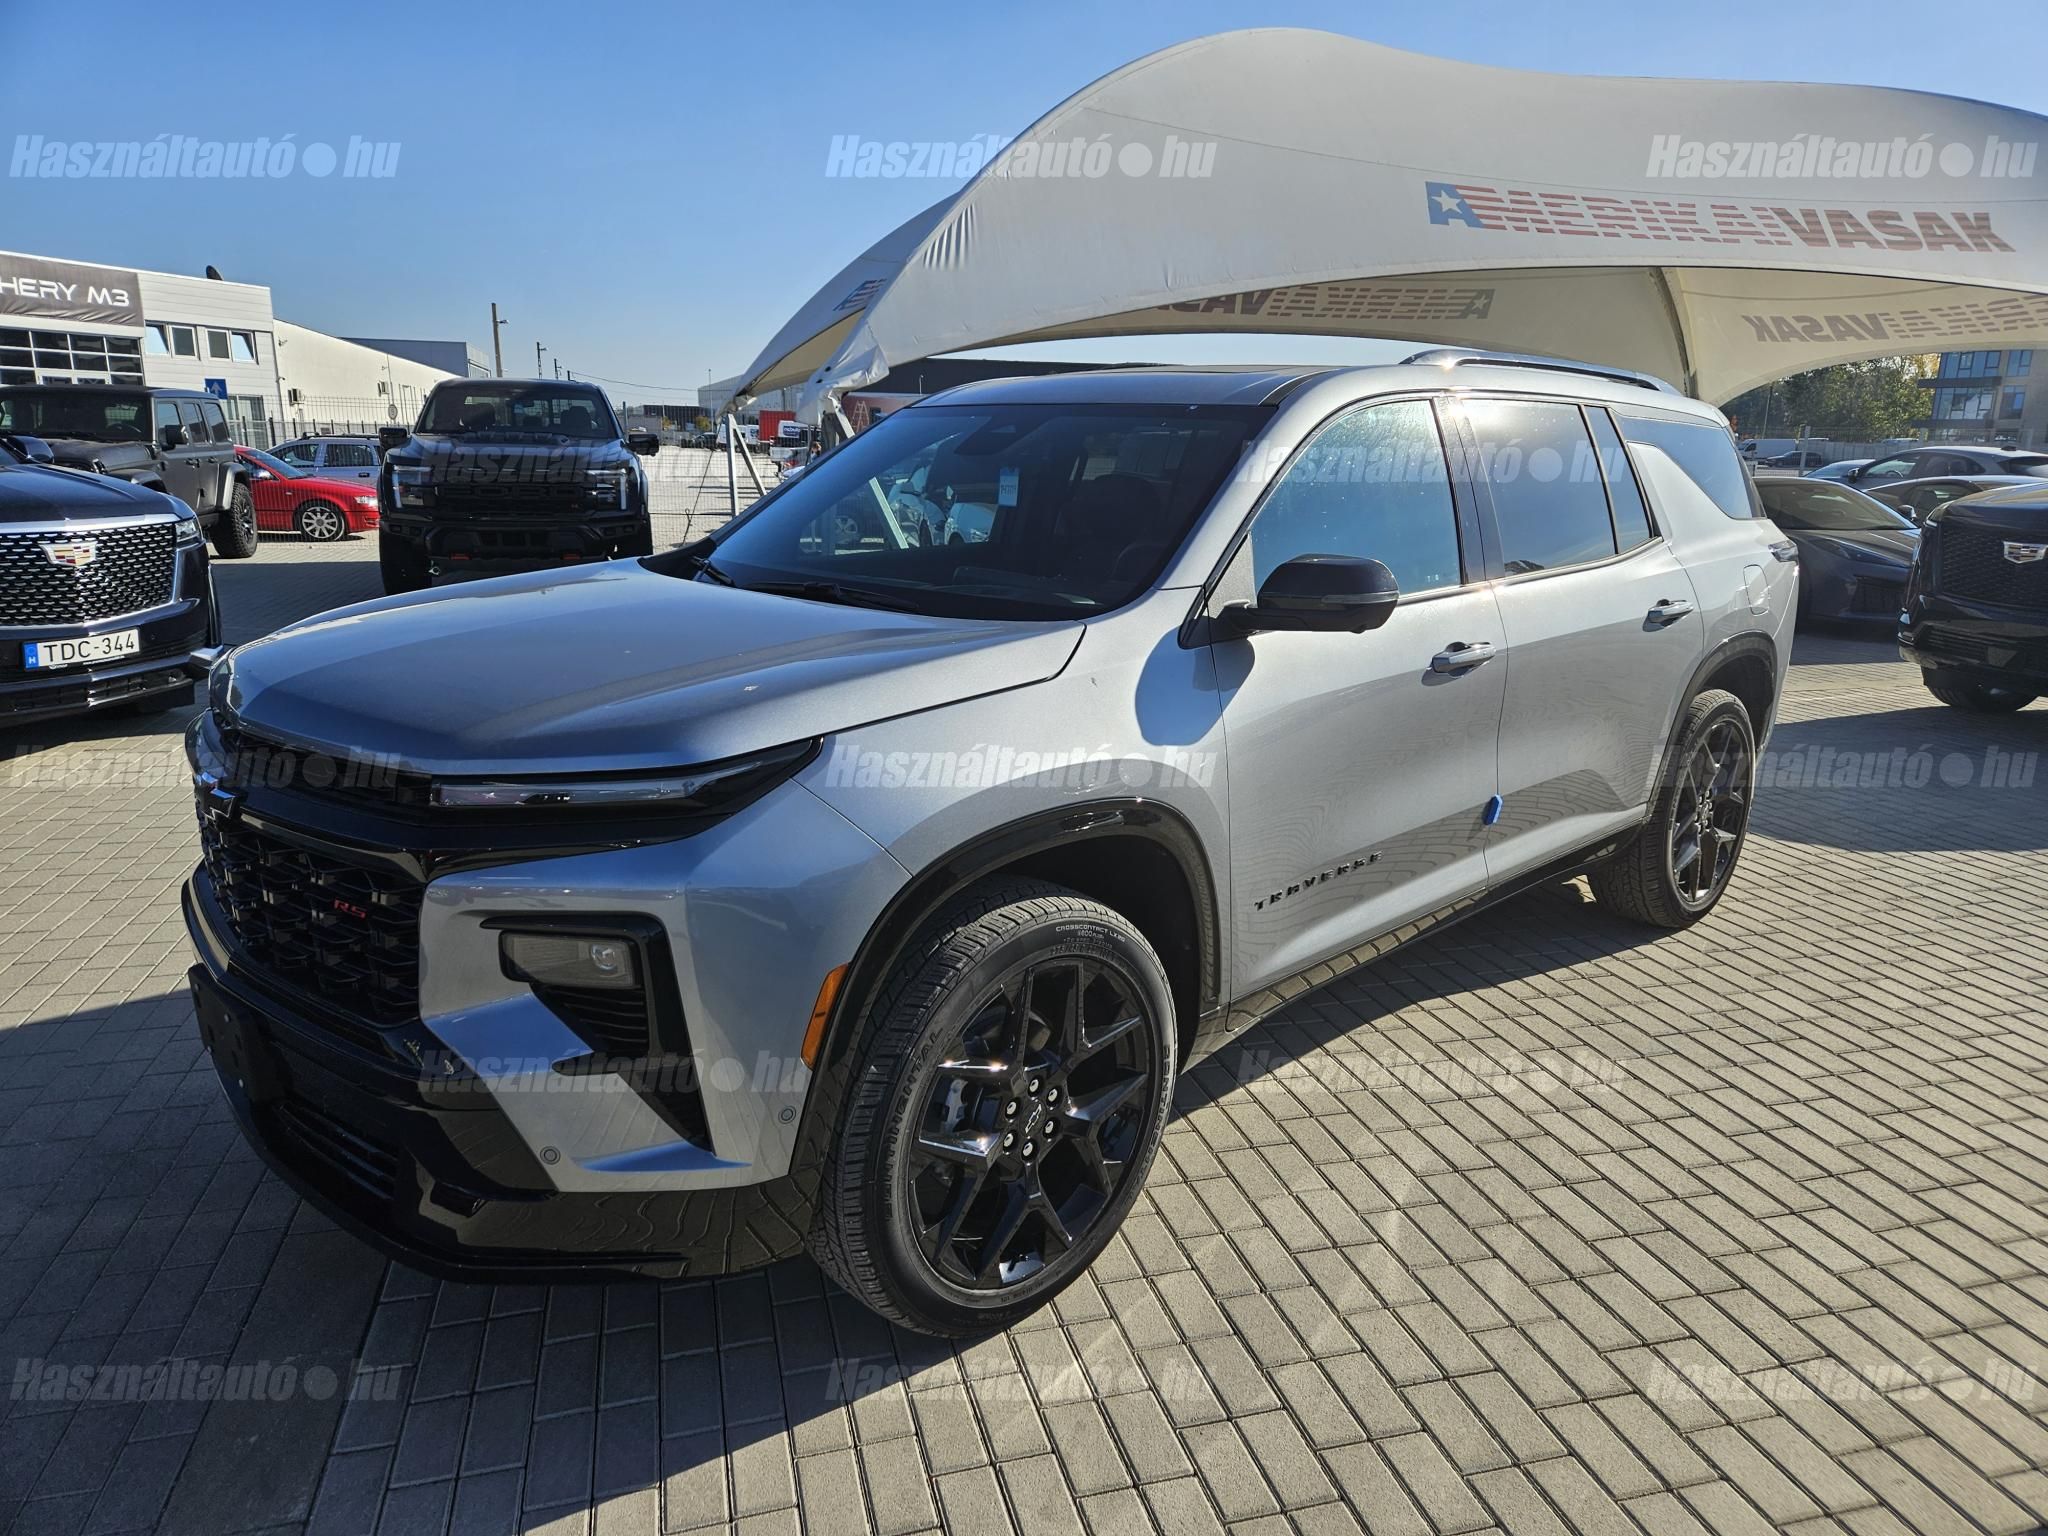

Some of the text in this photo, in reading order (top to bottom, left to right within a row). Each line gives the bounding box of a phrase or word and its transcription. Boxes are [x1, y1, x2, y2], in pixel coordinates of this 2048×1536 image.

[87, 286, 129, 307] M3
[43, 633, 136, 663] TDC-344
[1254, 851, 1383, 911] TRAVERSE
[334, 899, 367, 919] RS
